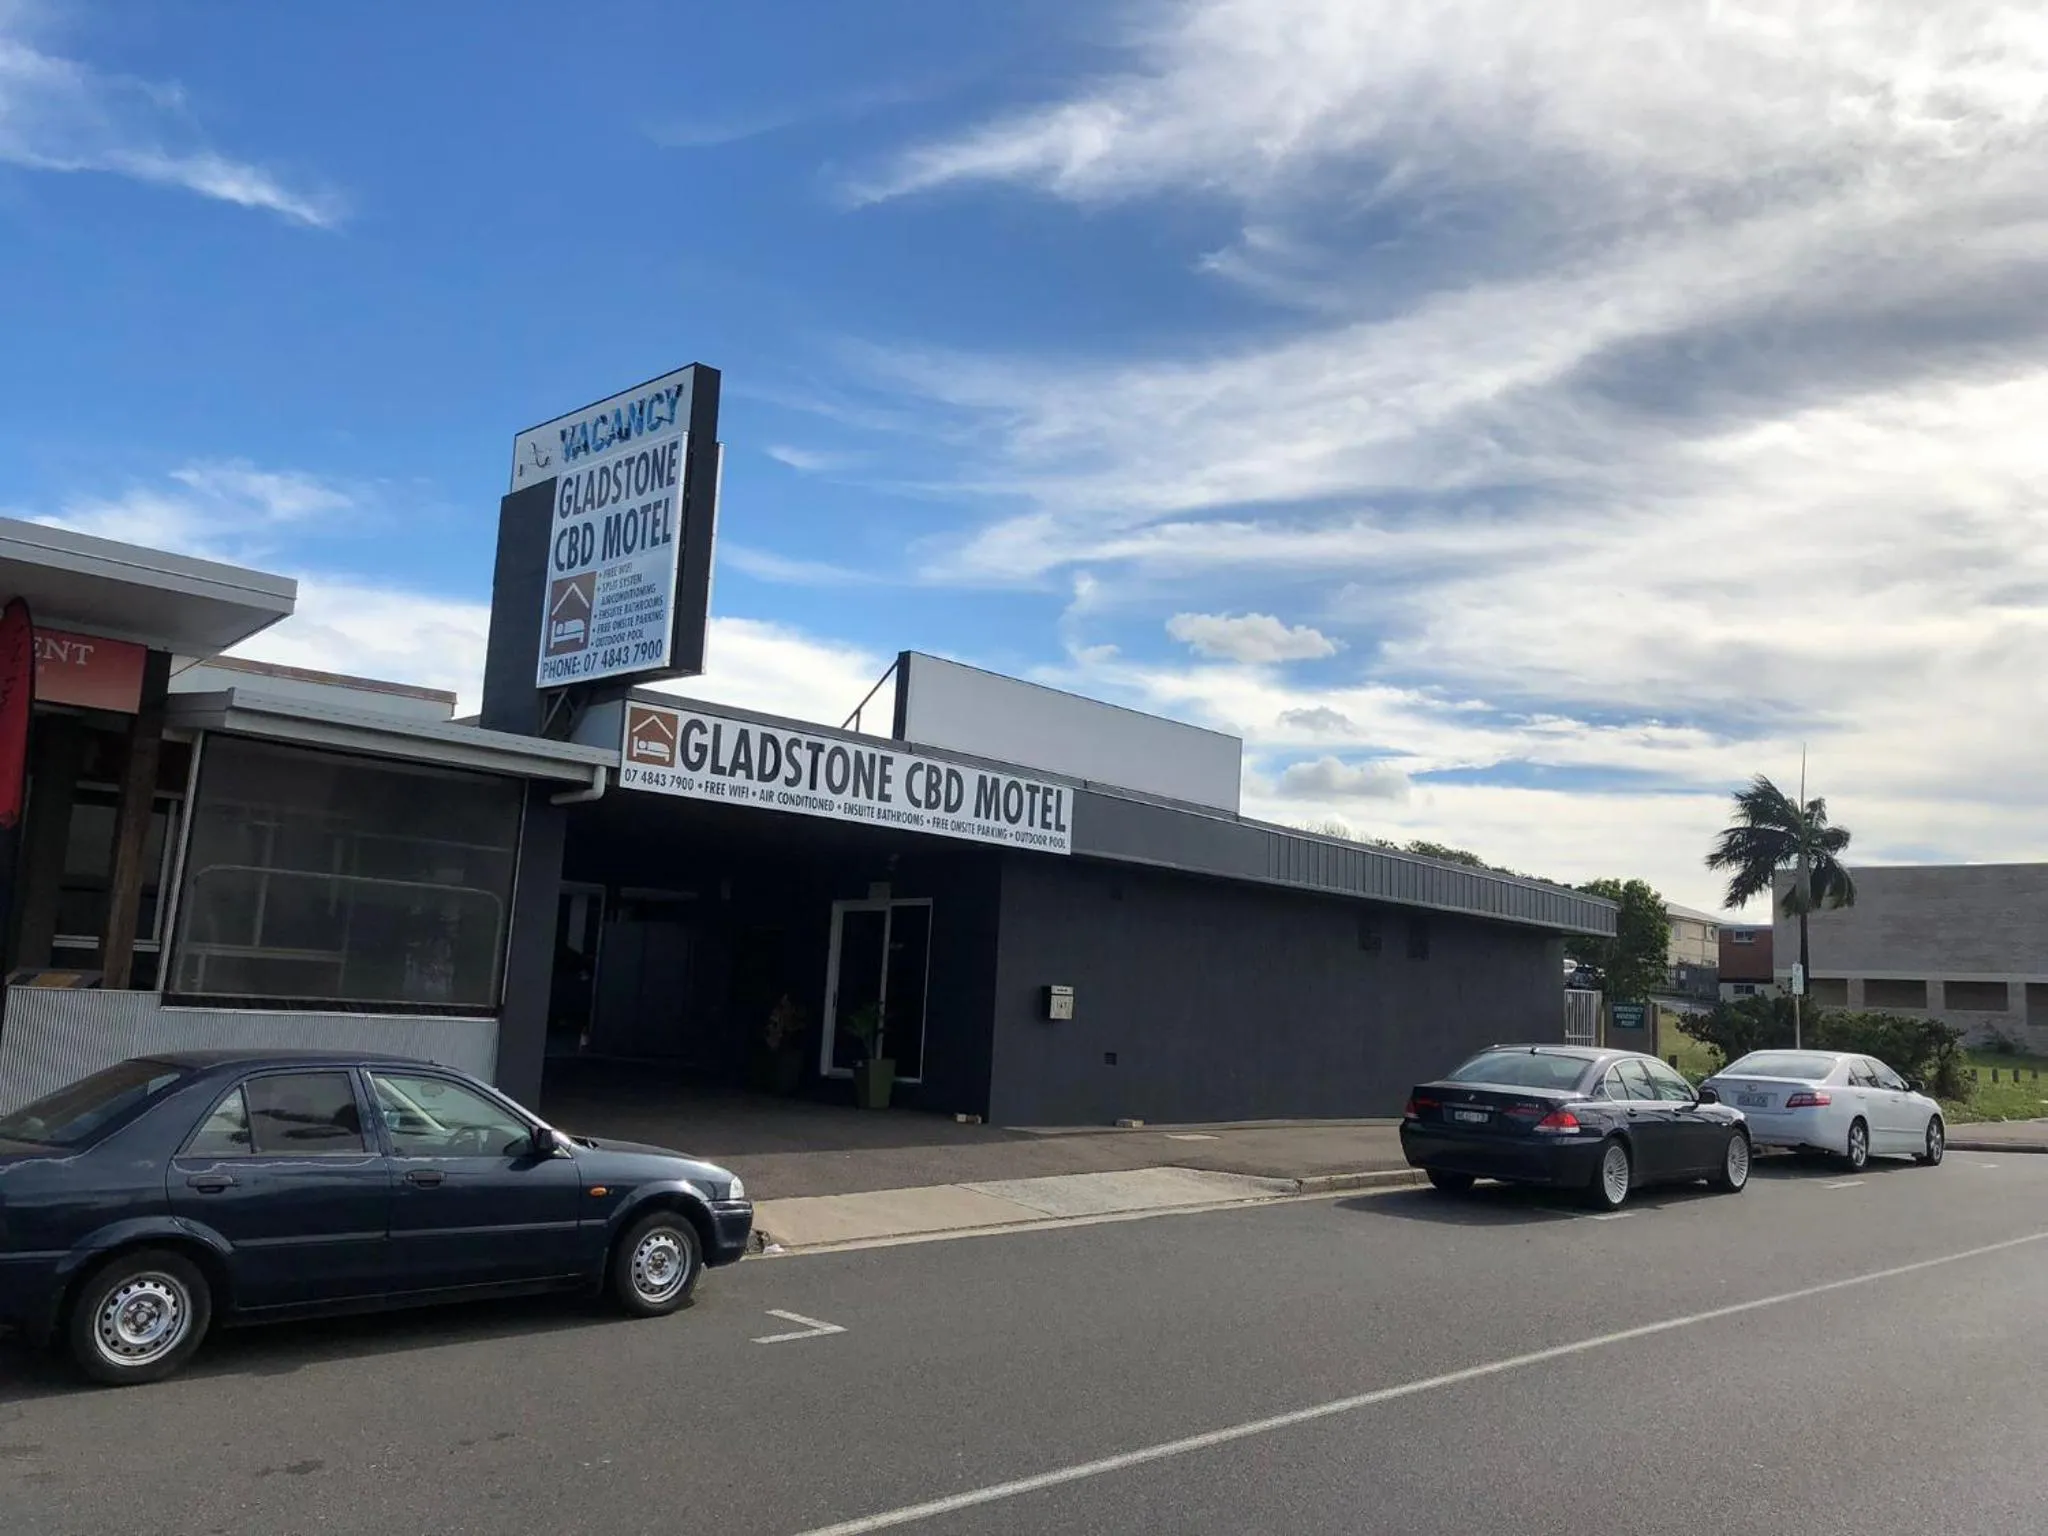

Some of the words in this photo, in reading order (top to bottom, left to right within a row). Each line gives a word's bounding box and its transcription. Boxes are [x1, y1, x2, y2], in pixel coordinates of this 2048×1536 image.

[560, 384, 684, 463] VACANCY
[559, 440, 679, 519] GLADSTONE
[554, 521, 595, 572] CBD
[601, 497, 672, 561] MOTEL
[603, 568, 617, 579] FREE
[620, 573, 643, 587] SYSTEM
[597, 621, 612, 634] FREE
[613, 617, 634, 631] ONSITE
[635, 609, 664, 626] PARKING
[598, 605, 623, 620] ENSUITE
[624, 594, 664, 614] BATHROOMS
[542, 656, 580, 680] PHONE:
[583, 652, 599, 673] 07
[601, 645, 631, 670] 4843
[633, 638, 663, 664] 7900
[595, 632, 626, 648] OUTDOOR
[627, 628, 645, 641] POOL
[680, 718, 894, 803] GLADSTONE
[905, 761, 965, 814] CBD
[974, 774, 1067, 833] MOTEL
[624, 768, 638, 782] 07
[641, 771, 667, 787] 4843
[669, 775, 695, 791] 7900
[704, 780, 726, 796] FREE
[728, 783, 749, 799] WIFI
[759, 789, 774, 802] AIR
[777, 791, 835, 812] CONDITIONED
[843, 802, 875, 819] ENSUITE
[877, 808, 924, 827] BATHROOMS
[932, 816, 949, 831] FREE
[950, 819, 975, 835] ONSITE
[977, 824, 1008, 840] PARKING
[1015, 831, 1047, 846] OUTDOOR
[1050, 835, 1066, 849] POOL
